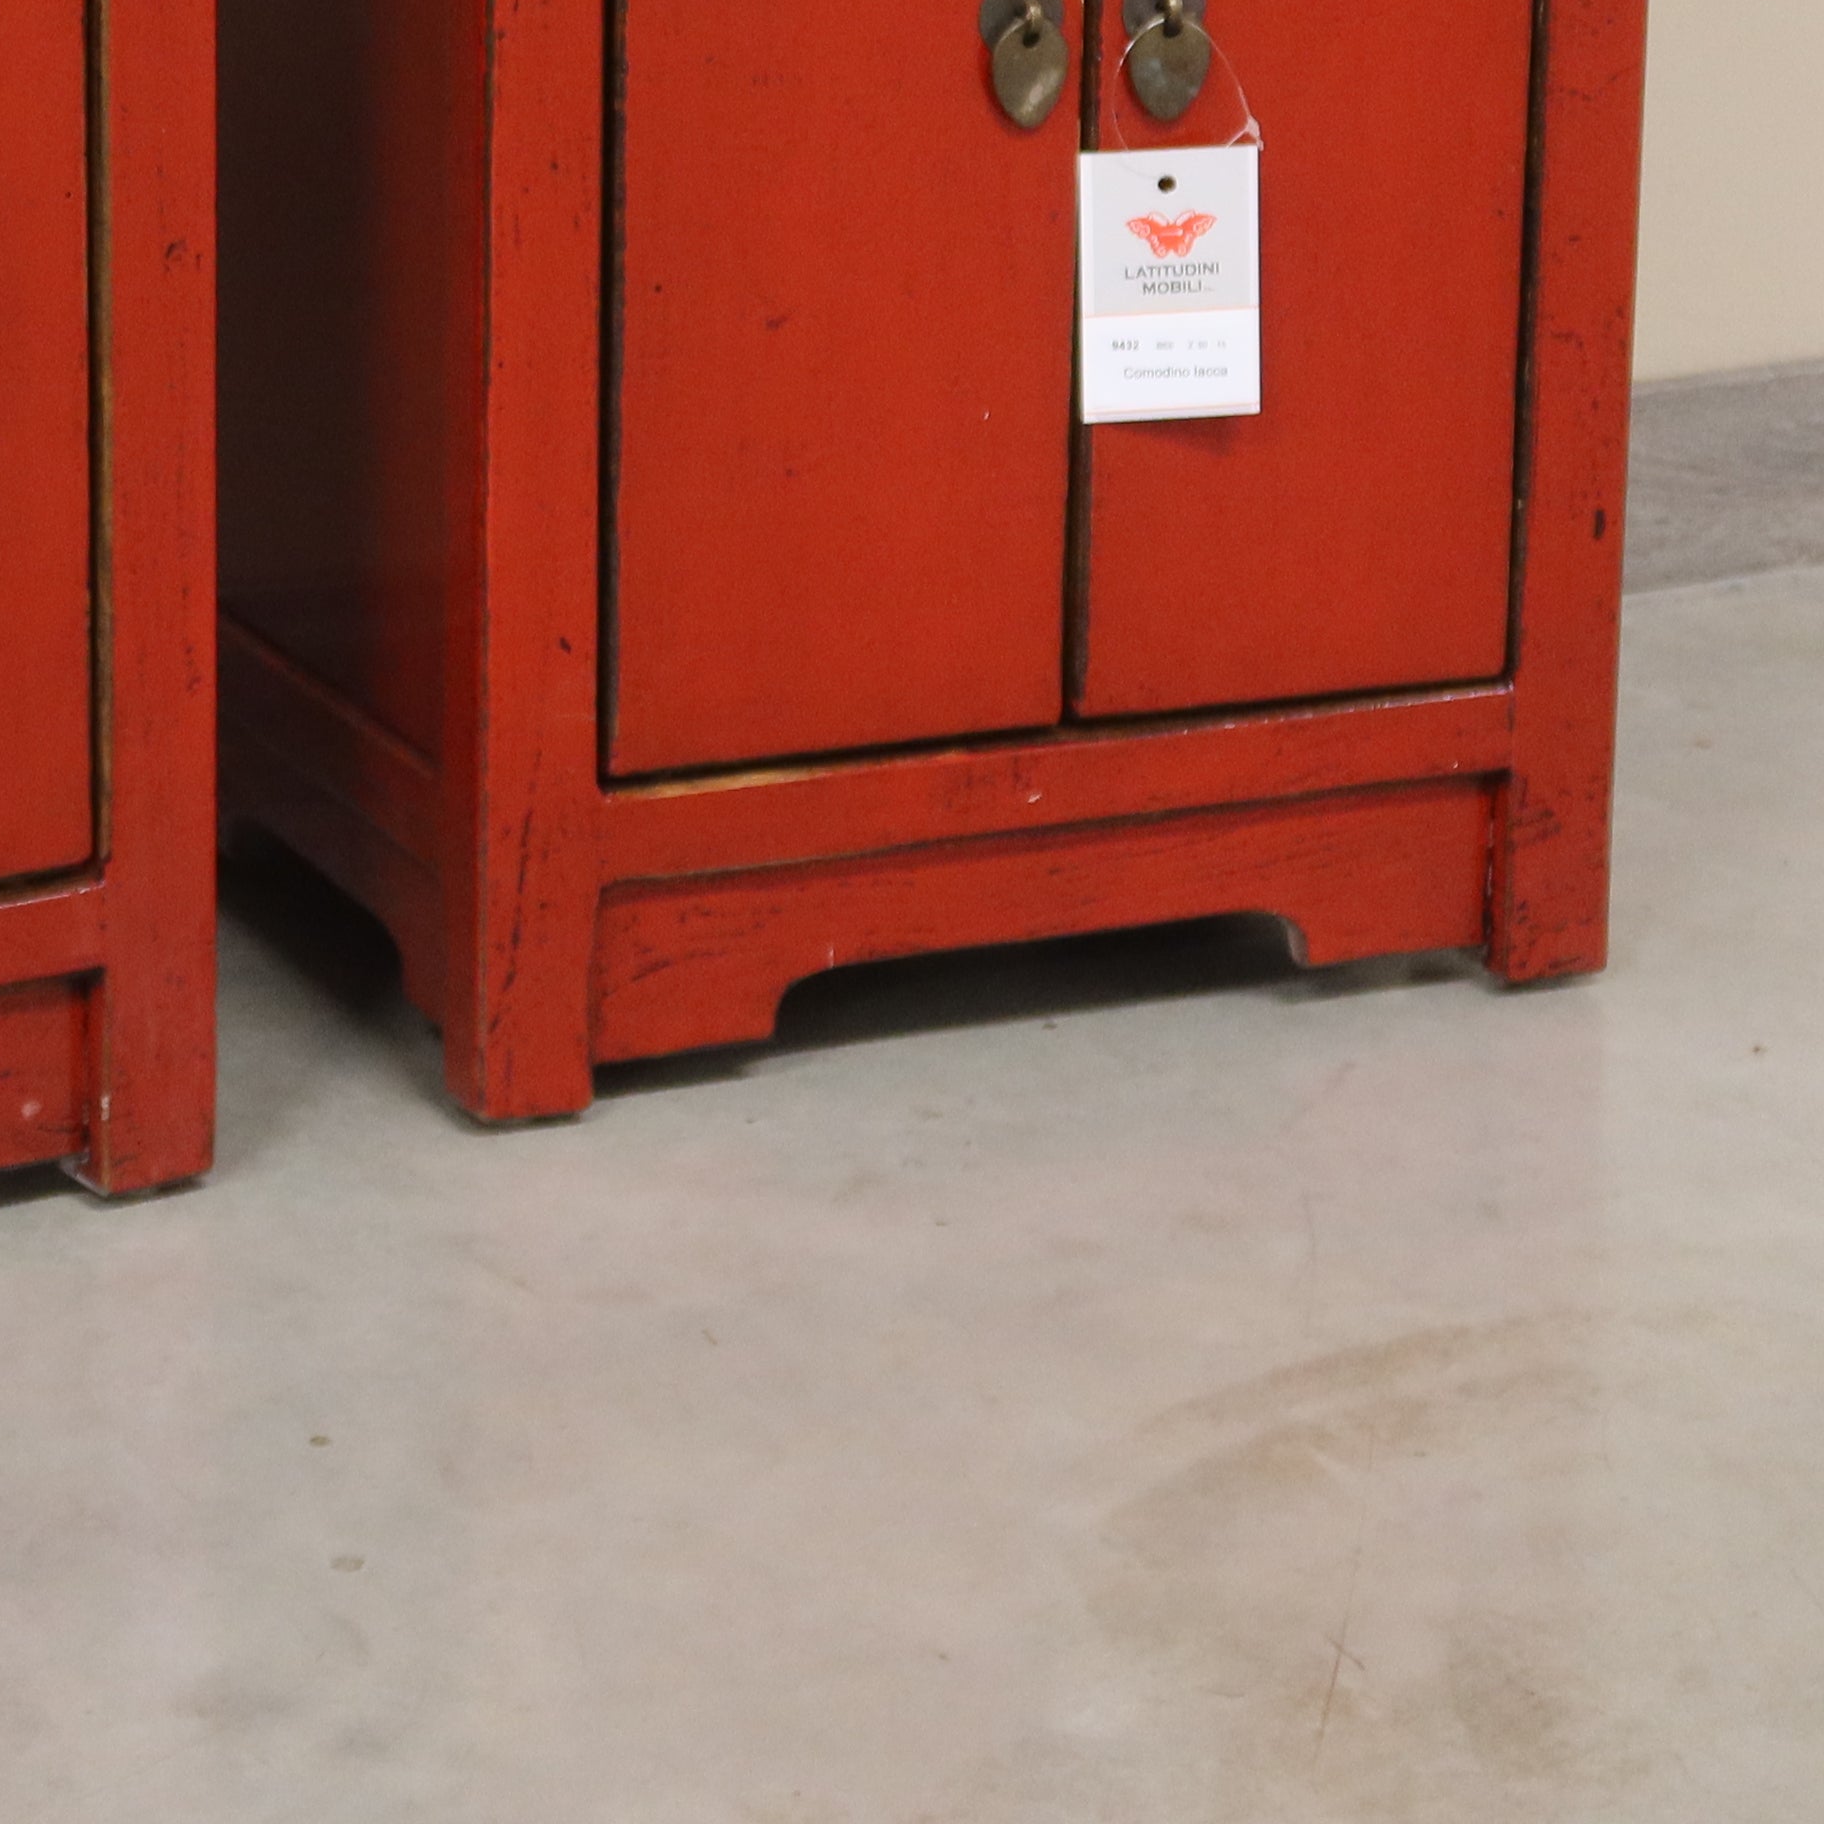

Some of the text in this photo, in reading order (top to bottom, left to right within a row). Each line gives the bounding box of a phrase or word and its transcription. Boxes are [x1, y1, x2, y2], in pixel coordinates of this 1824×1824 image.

[1124, 262, 1220, 281] LATITUDINI
[1142, 279, 1202, 296] MOBILI
[1123, 363, 1228, 380] Comodino lacca
